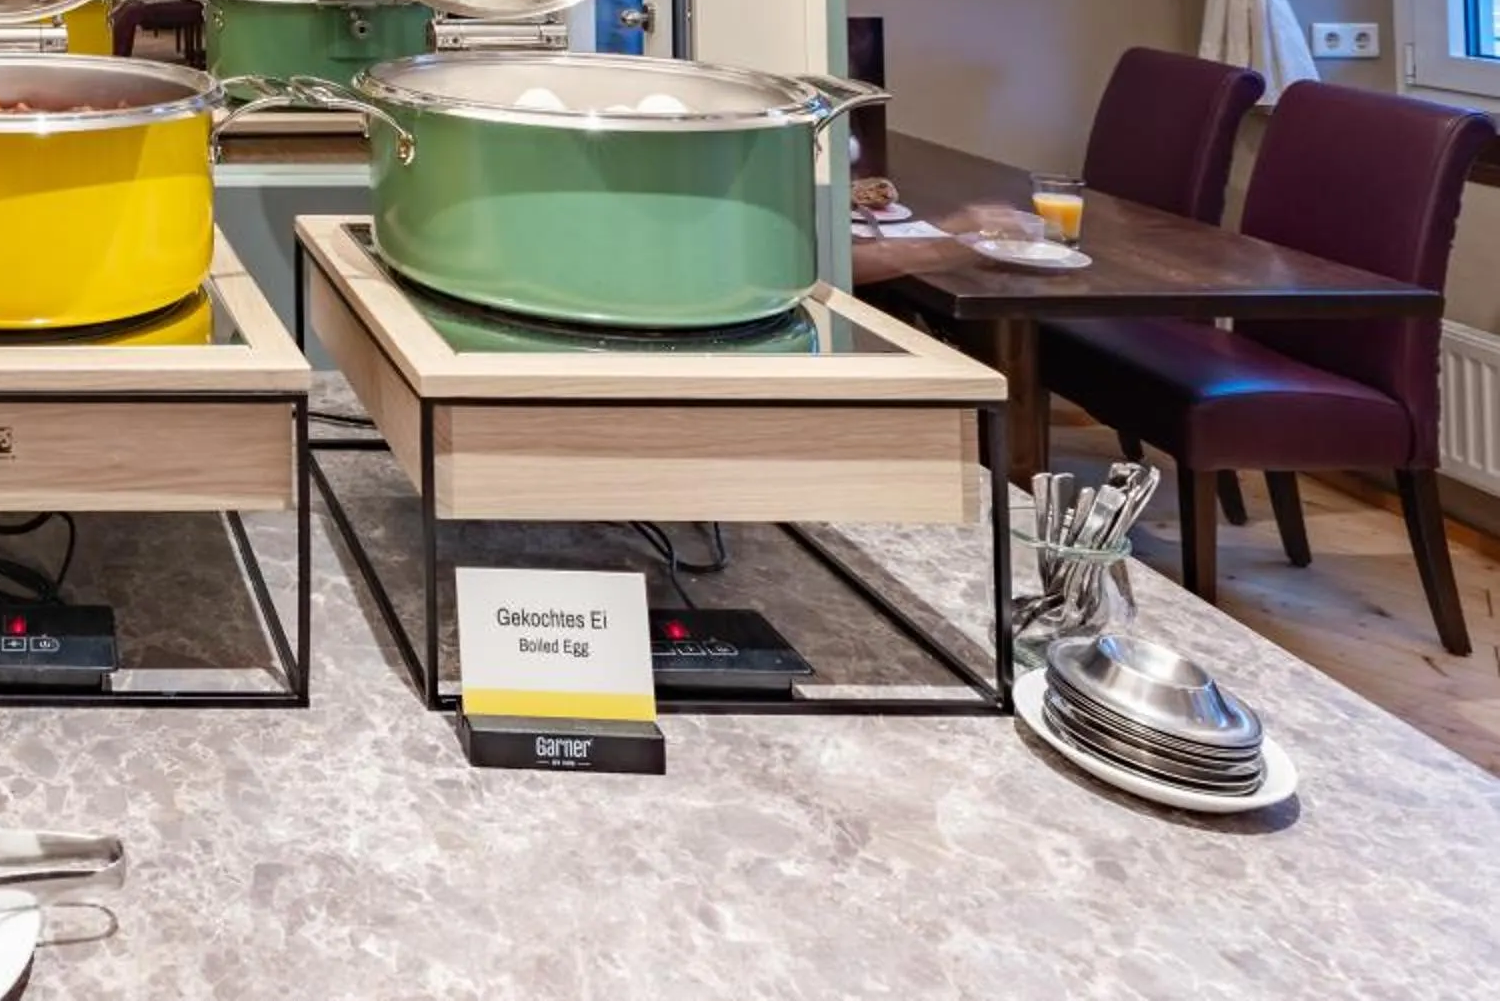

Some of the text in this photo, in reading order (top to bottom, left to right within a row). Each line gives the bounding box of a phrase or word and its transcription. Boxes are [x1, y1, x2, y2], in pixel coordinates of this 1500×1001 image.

[497, 607, 608, 630] Gekochtes Ei
[519, 637, 589, 658] Boiled Egg
[535, 736, 593, 758] Garner
